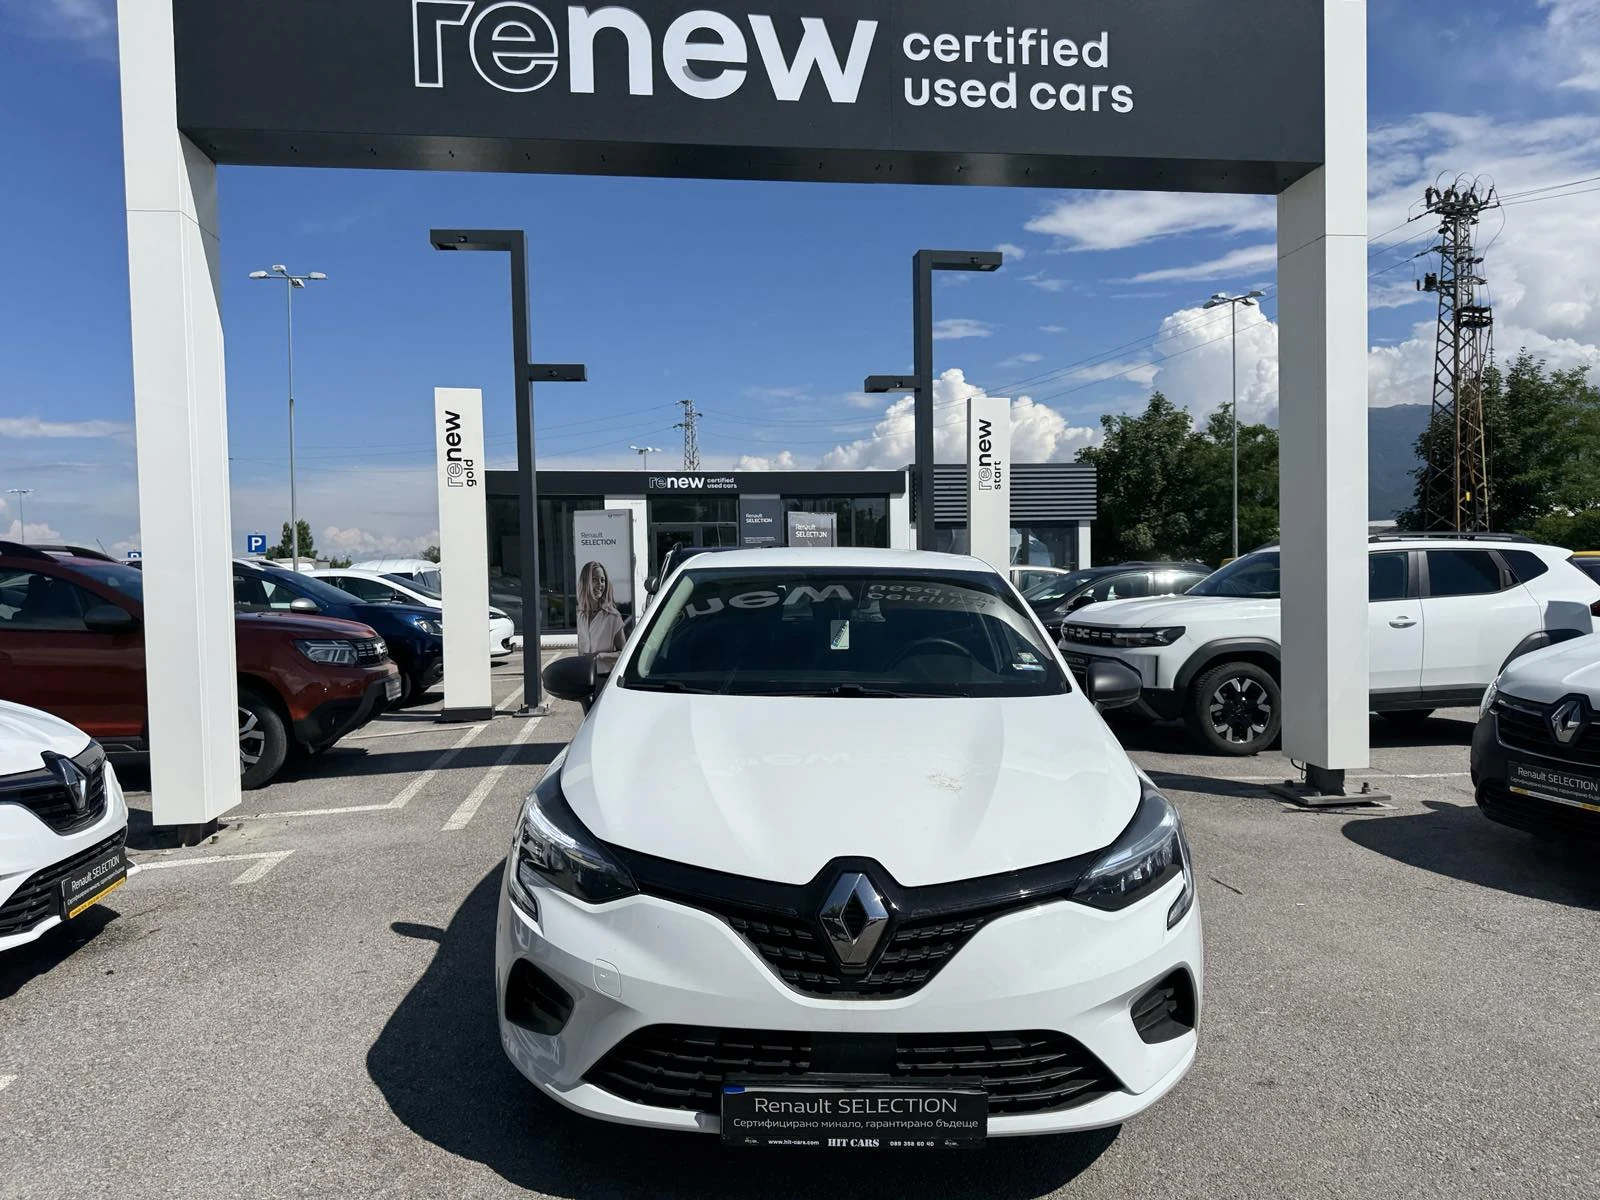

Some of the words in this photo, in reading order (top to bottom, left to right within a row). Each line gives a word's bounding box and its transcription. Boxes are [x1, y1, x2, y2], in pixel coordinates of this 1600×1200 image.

[411, 0, 880, 104] renew
[903, 26, 1110, 70] certified
[903, 72, 1018, 109] used
[1029, 81, 1135, 114] cars
[445, 410, 464, 488] renew
[978, 418, 992, 491] renew
[463, 458, 477, 488] gold
[648, 476, 705, 489] renew
[994, 460, 1002, 490] start
[251, 537, 262, 551] P
[580, 531, 603, 539] Renault
[1517, 766, 1546, 781] Renault
[1547, 773, 1598, 792] SELECTION
[71, 871, 92, 892] Renault
[92, 854, 120, 880] SELECTION
[754, 1097, 833, 1114] Renault
[838, 1097, 957, 1114] SELECTION
[733, 1117, 819, 1130] Сертифицирано
[821, 1119, 864, 1130] минало,
[866, 1118, 933, 1130] гарантирано
[935, 1117, 979, 1130] бъдеще
[827, 1138, 849, 1147] HIT
[850, 1138, 880, 1148] CARS
